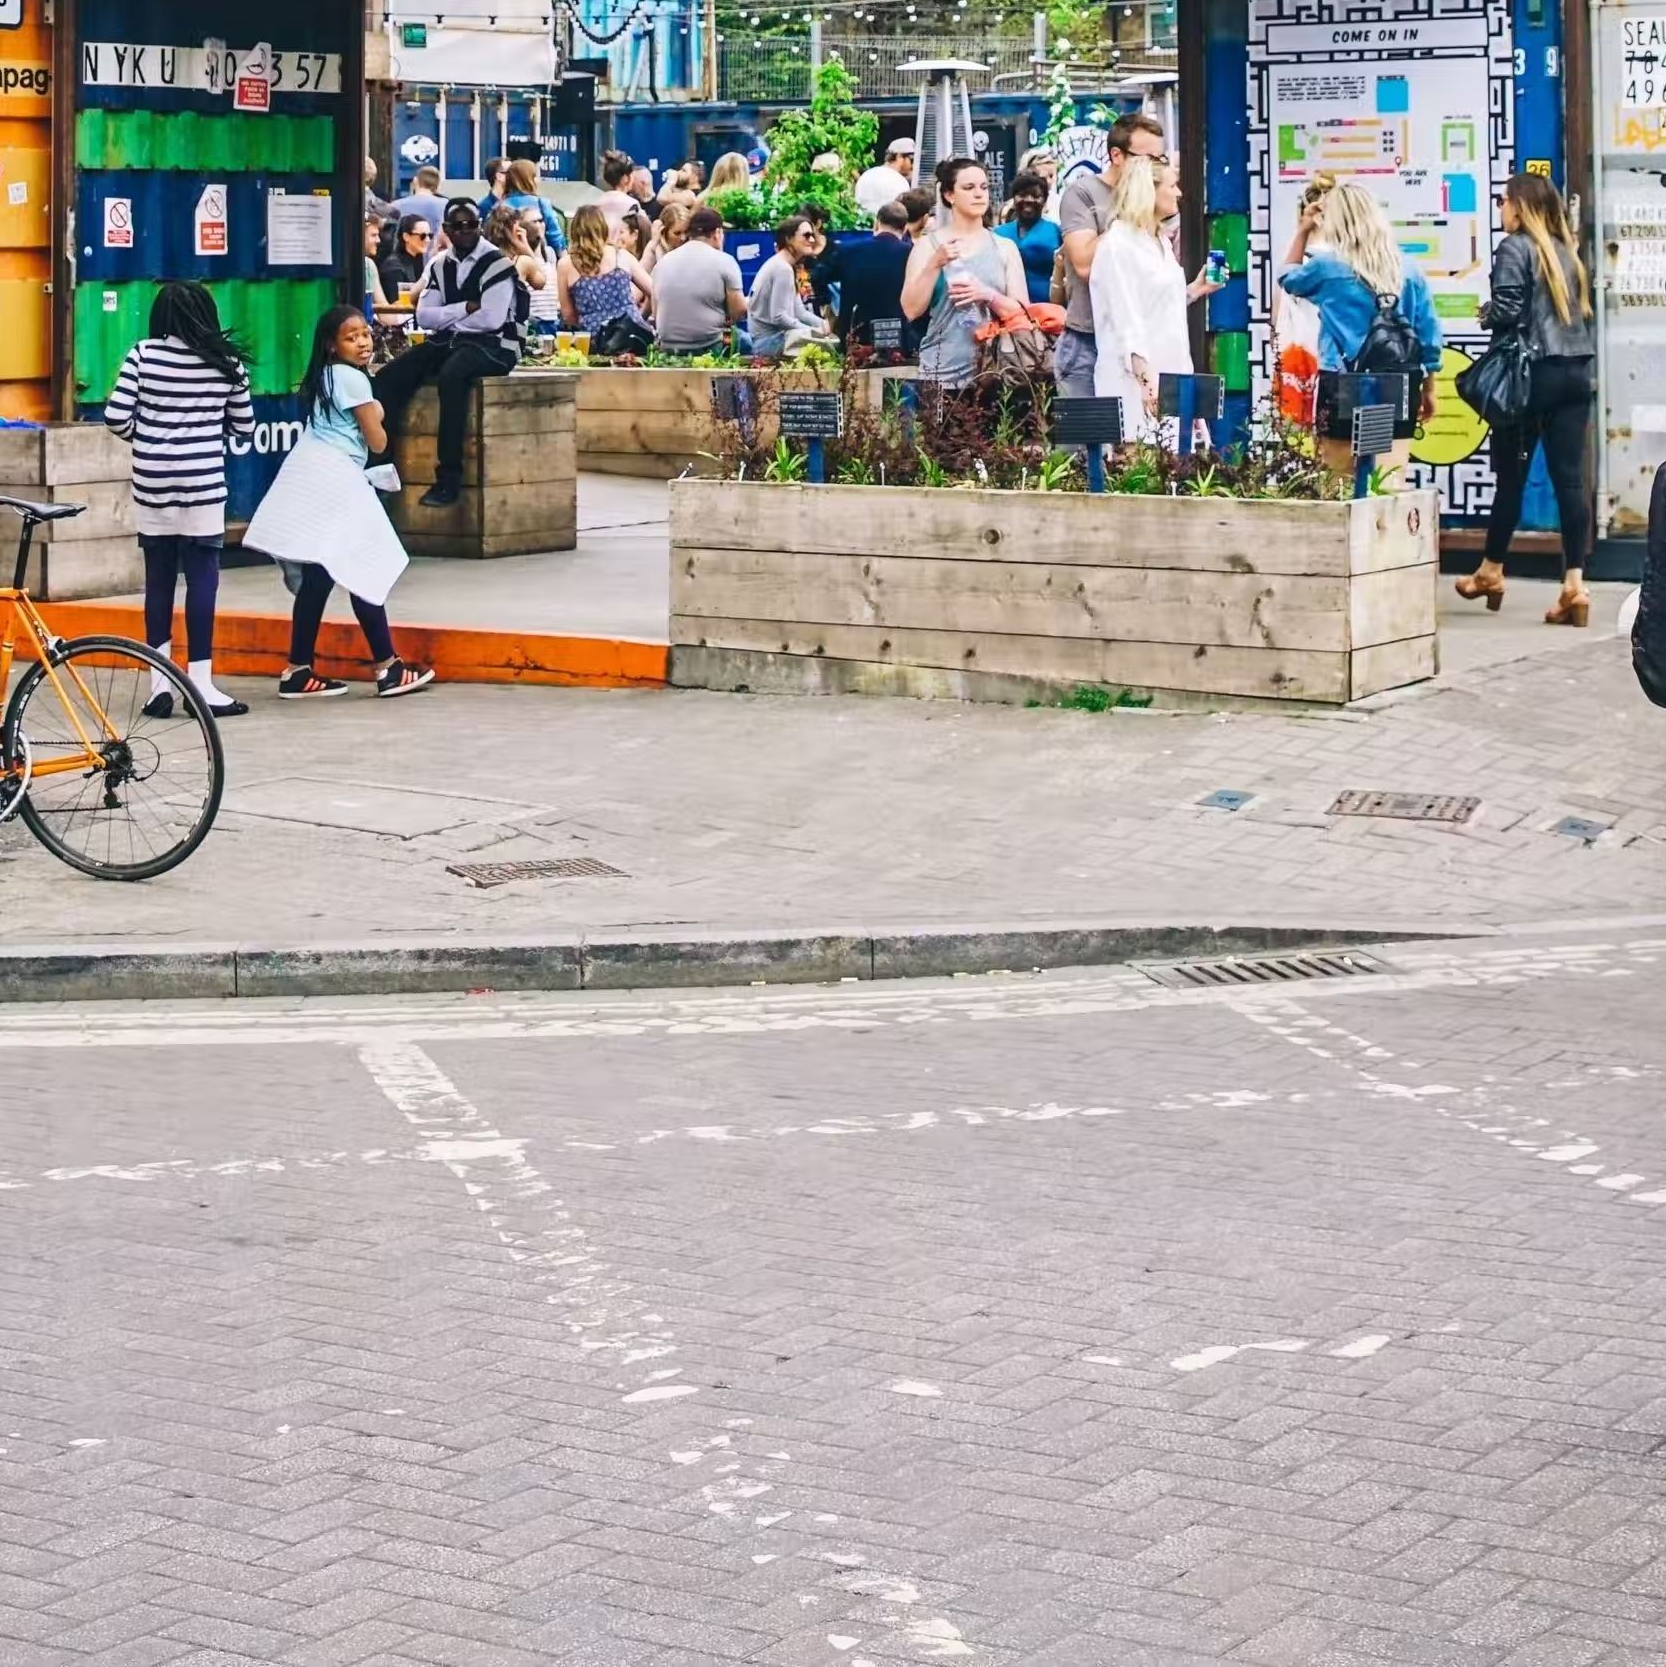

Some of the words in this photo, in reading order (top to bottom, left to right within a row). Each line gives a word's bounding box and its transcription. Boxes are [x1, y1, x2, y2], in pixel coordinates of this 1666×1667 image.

[1331, 29, 1372, 44] COME
[1377, 28, 1398, 42] ON
[1403, 28, 1419, 41] IN
